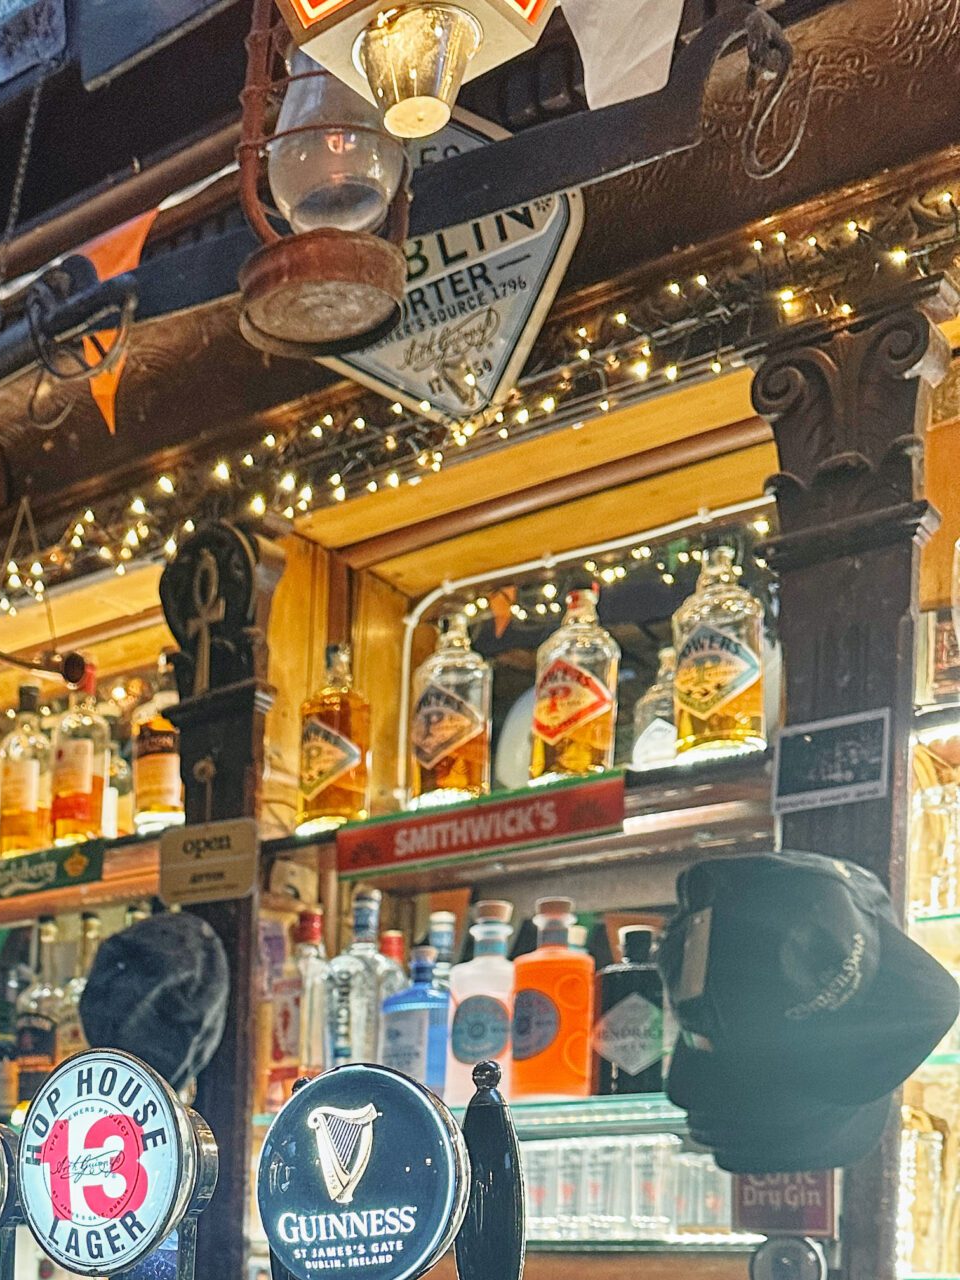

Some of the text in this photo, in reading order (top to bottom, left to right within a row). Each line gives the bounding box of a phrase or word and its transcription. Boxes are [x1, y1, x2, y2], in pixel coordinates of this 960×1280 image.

[405, 205, 535, 282] BLIN
[429, 294, 488, 324] SOURCE
[491, 275, 528, 301] 1796
[182, 834, 231, 859] open
[394, 796, 558, 857] SMITHWICK'S
[25, 1066, 167, 1166] HOP HOUSE
[98, 1107, 130, 1137] PROJECT
[40, 1114, 149, 1221] 13
[48, 1209, 146, 1260] LAGER
[277, 1206, 417, 1243] GUINNESS
[293, 1240, 404, 1259] ST JAMES'S GATE
[348, 1254, 393, 1267] IRELAND
